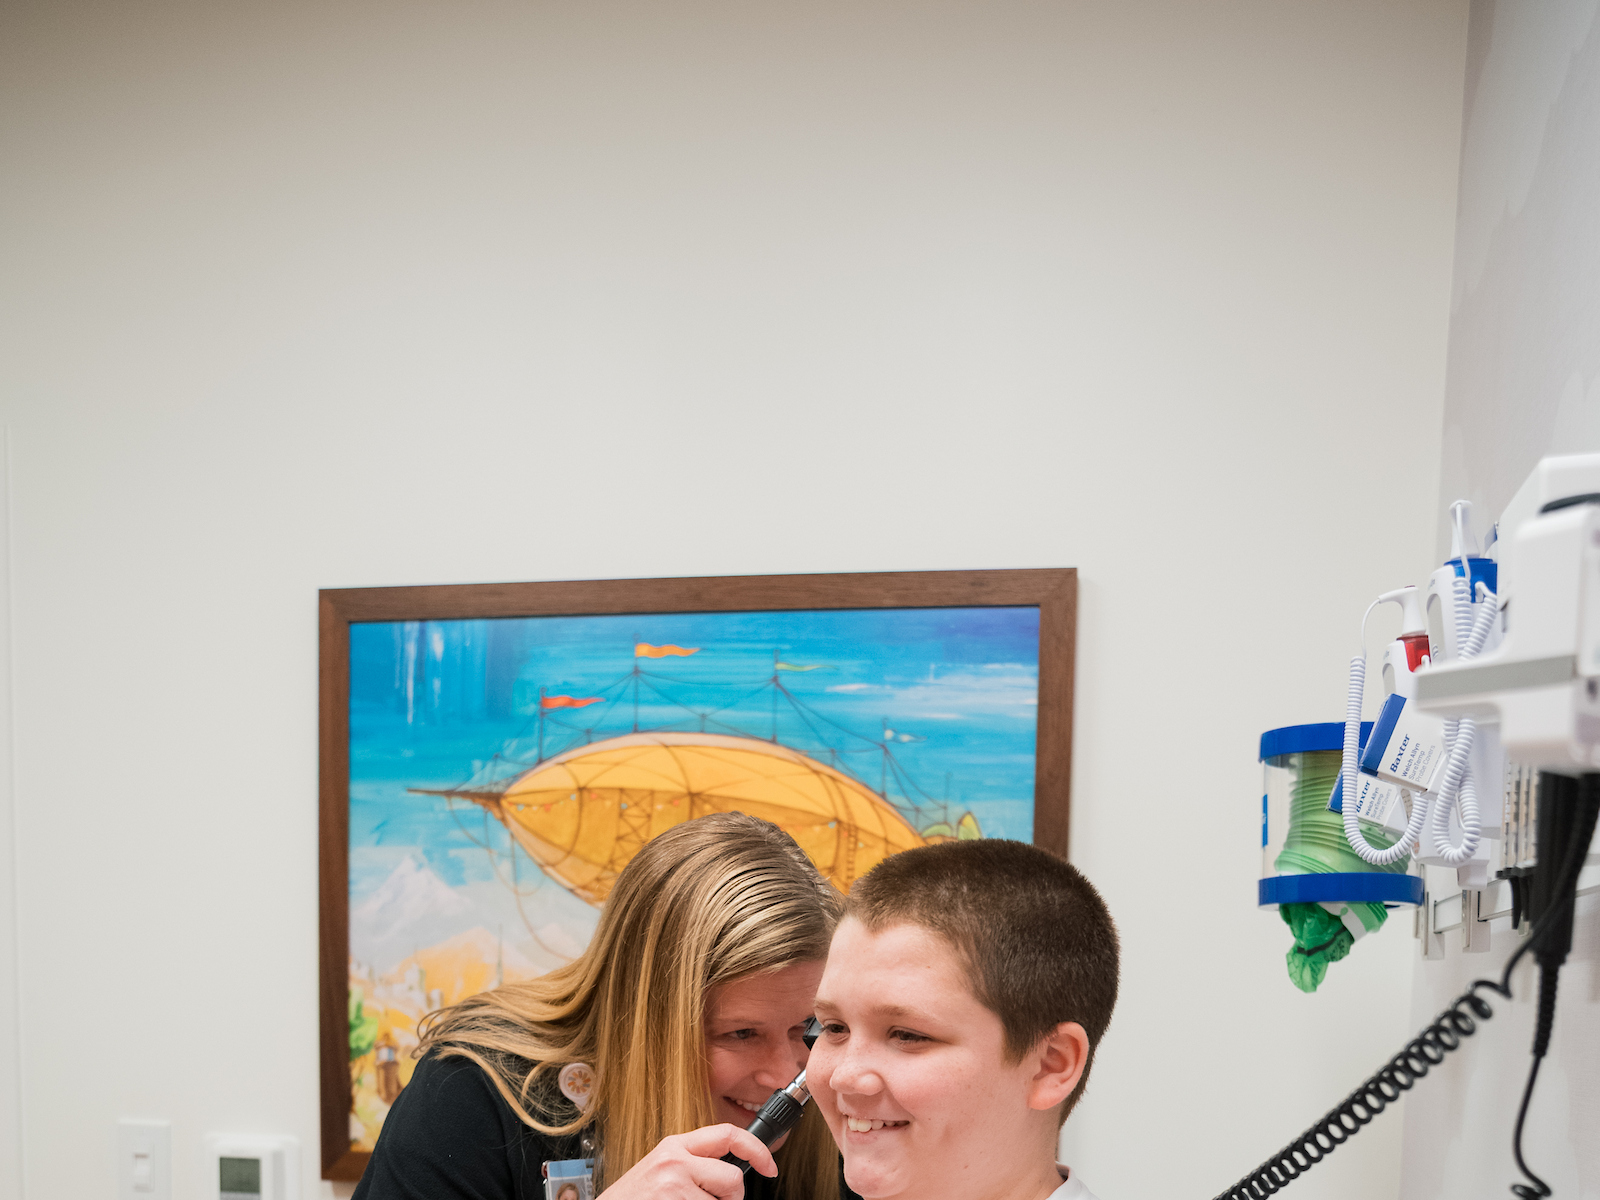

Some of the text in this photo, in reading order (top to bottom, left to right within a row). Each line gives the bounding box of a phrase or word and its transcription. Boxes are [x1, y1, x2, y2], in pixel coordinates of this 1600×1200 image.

[1389, 733, 1410, 773] Baxter
[1401, 742, 1421, 777] Welch Allyn
[1408, 750, 1426, 780] SureTemp
[1415, 764, 1427, 783] Probe
[1422, 745, 1436, 765] Covers
